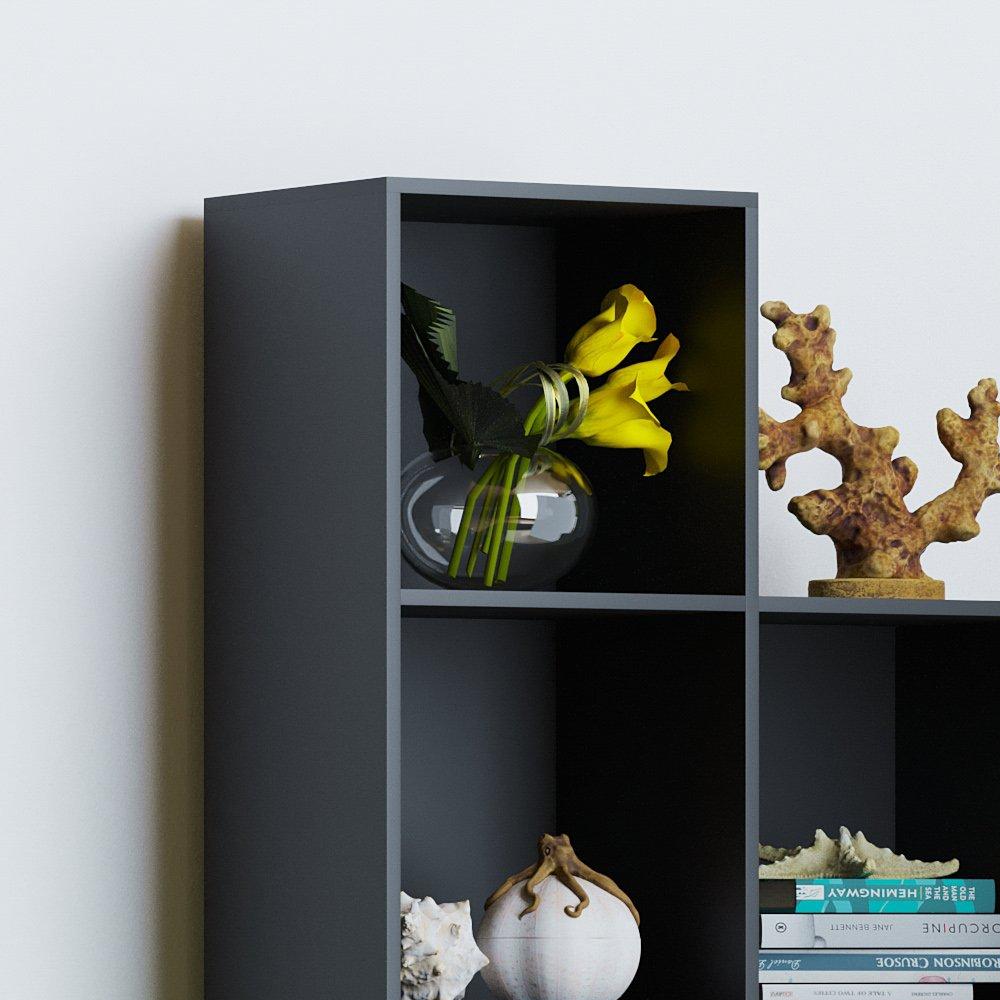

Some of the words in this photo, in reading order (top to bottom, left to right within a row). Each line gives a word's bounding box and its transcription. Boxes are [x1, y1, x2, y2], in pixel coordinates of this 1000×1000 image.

[828, 888, 917, 898] HEMINGWAY
[933, 886, 941, 901] THE
[959, 886, 967, 901] OLD
[968, 886, 976, 901] THE
[766, 959, 802, 970] Daniel
[876, 957, 929, 969] CRUSOE
